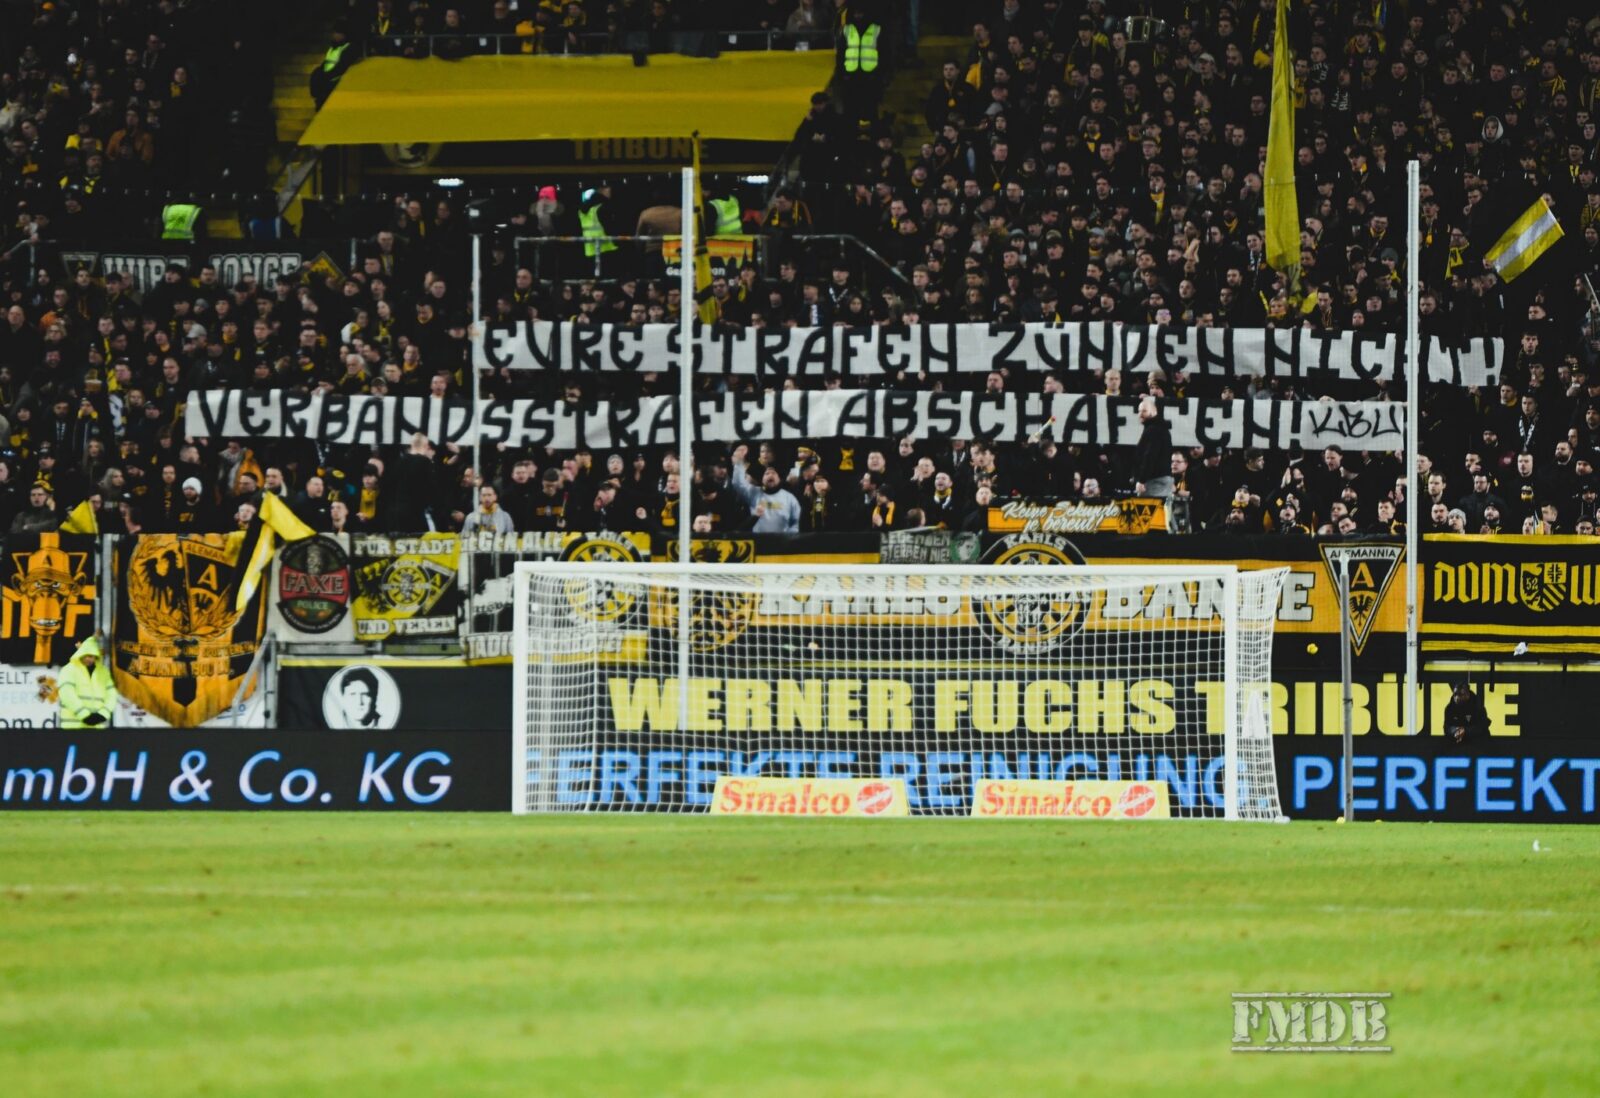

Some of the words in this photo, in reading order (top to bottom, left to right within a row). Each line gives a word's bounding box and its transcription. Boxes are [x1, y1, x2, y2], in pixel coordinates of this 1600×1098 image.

[484, 321, 644, 371] EURE
[667, 323, 957, 375] STRAFEN
[988, 321, 1234, 375] ZÜNDEN
[1265, 326, 1496, 386] NICHT!
[199, 389, 808, 449] VERBANDSSTRAFEN
[1001, 500, 1048, 520] Keine
[1049, 499, 1121, 521] Sekunde
[1024, 517, 1041, 533] je
[1042, 515, 1102, 532] bereut!
[1005, 532, 1067, 551] KARLS
[284, 572, 345, 595] FAXE
[607, 677, 913, 733] WERNER
[934, 679, 1177, 735] FUCHS
[168, 749, 213, 803] &
[238, 750, 332, 804] Co.
[357, 750, 453, 804] KG
[718, 778, 852, 815] Sinalco
[979, 781, 1113, 818] Sinalco
